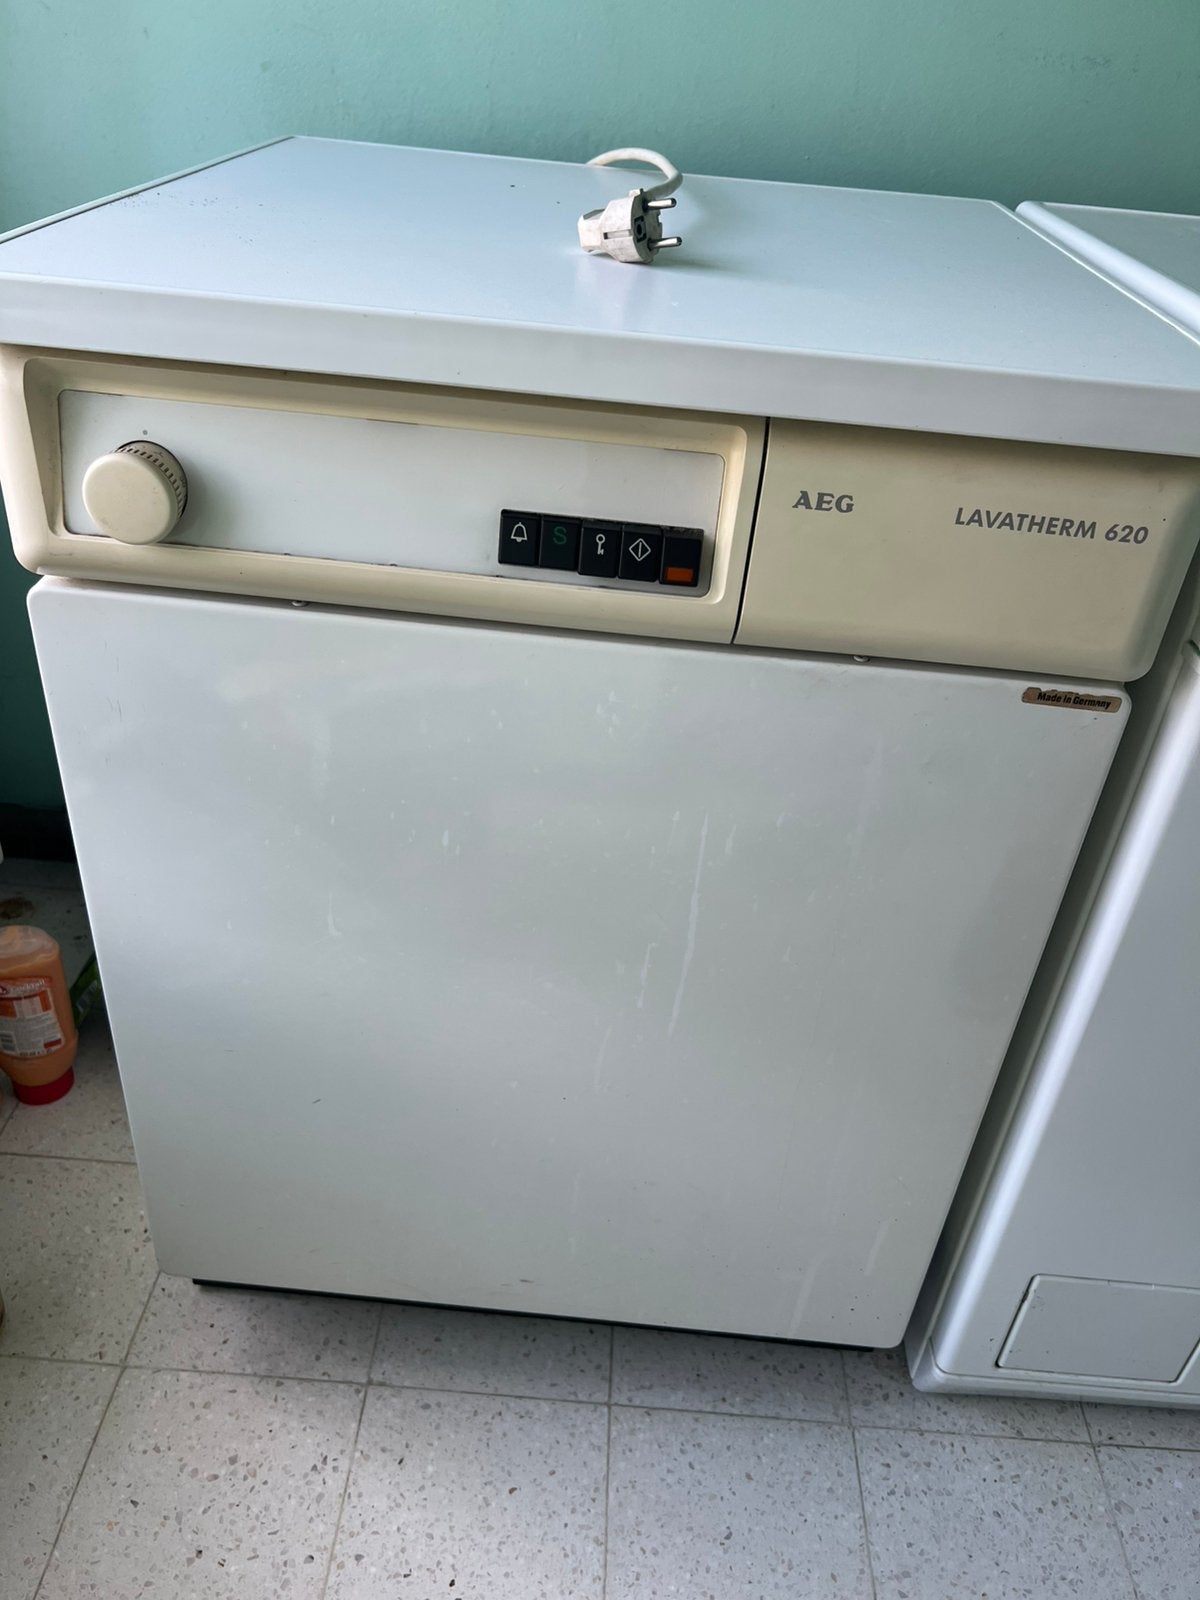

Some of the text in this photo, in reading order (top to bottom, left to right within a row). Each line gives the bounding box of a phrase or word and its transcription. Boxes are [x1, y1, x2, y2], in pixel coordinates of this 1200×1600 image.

[792, 490, 854, 513] AEG
[553, 526, 568, 545] S
[955, 507, 1150, 545] LAVATHERM 620
[1037, 692, 1062, 702] Made
[1072, 696, 1112, 709] Germany
